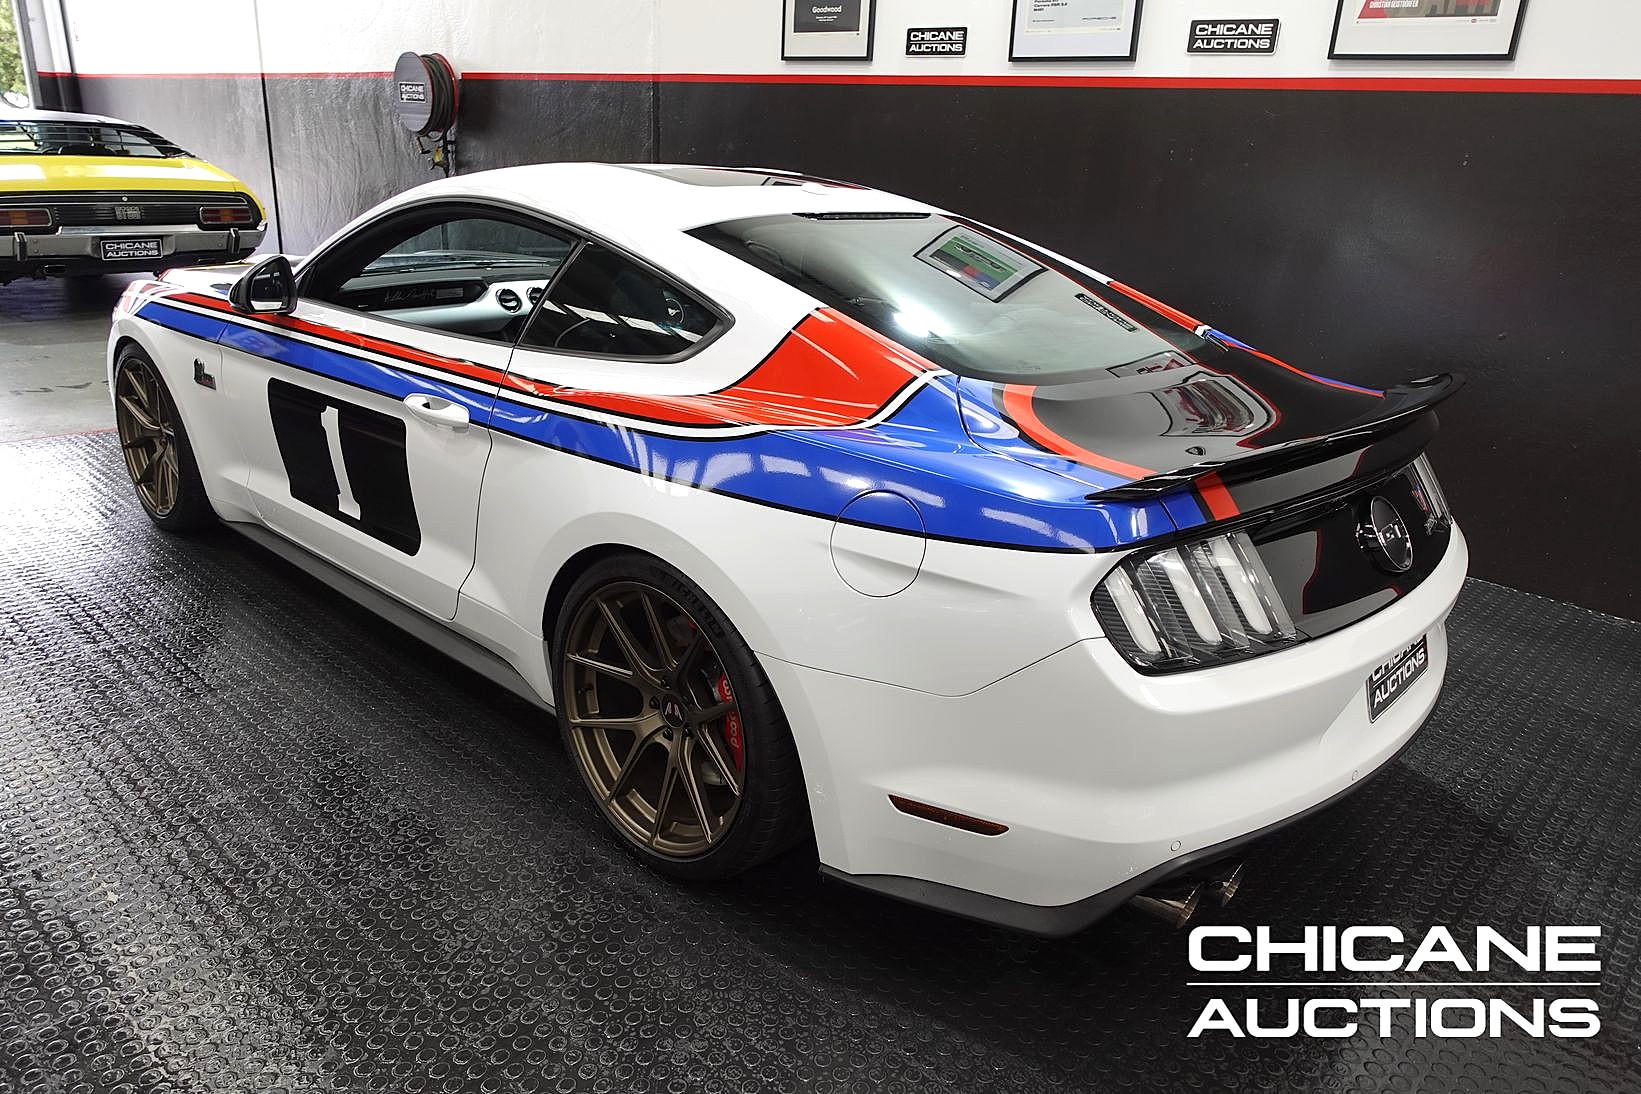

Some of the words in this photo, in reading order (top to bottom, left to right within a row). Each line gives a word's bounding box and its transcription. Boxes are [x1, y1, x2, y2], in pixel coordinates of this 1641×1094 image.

[812, 5, 842, 13] Goodwood
[1195, 24, 1274, 35] CHICANE
[910, 31, 964, 40] CHICANE
[909, 43, 963, 52] AUCTIONS
[1193, 39, 1271, 49] AUCTIONS
[105, 242, 158, 250] CHICANE
[1373, 648, 1425, 708] AUCTIONS
